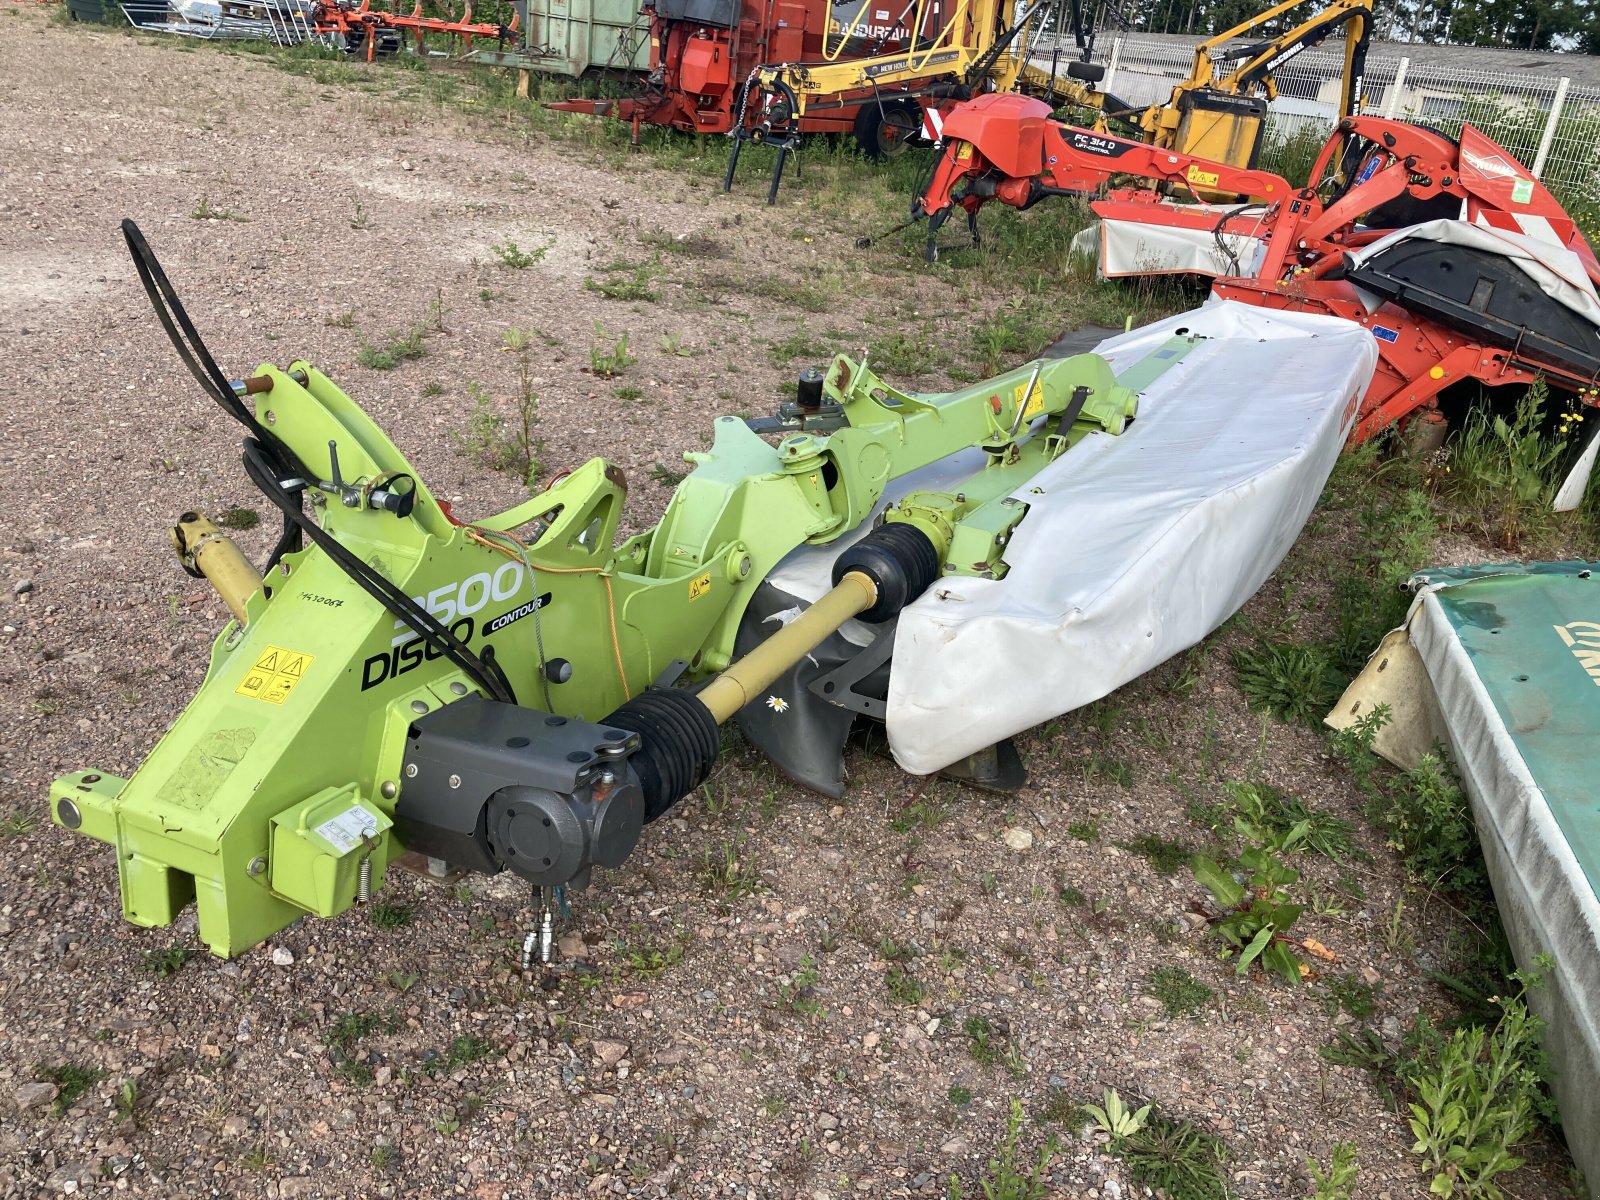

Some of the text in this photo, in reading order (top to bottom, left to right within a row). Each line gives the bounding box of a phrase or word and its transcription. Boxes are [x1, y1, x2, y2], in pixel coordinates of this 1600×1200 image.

[880, 60, 917, 72] NEW HOLLAD
[1074, 133, 1116, 150] FC 314 D
[491, 597, 543, 631] CONTOUR
